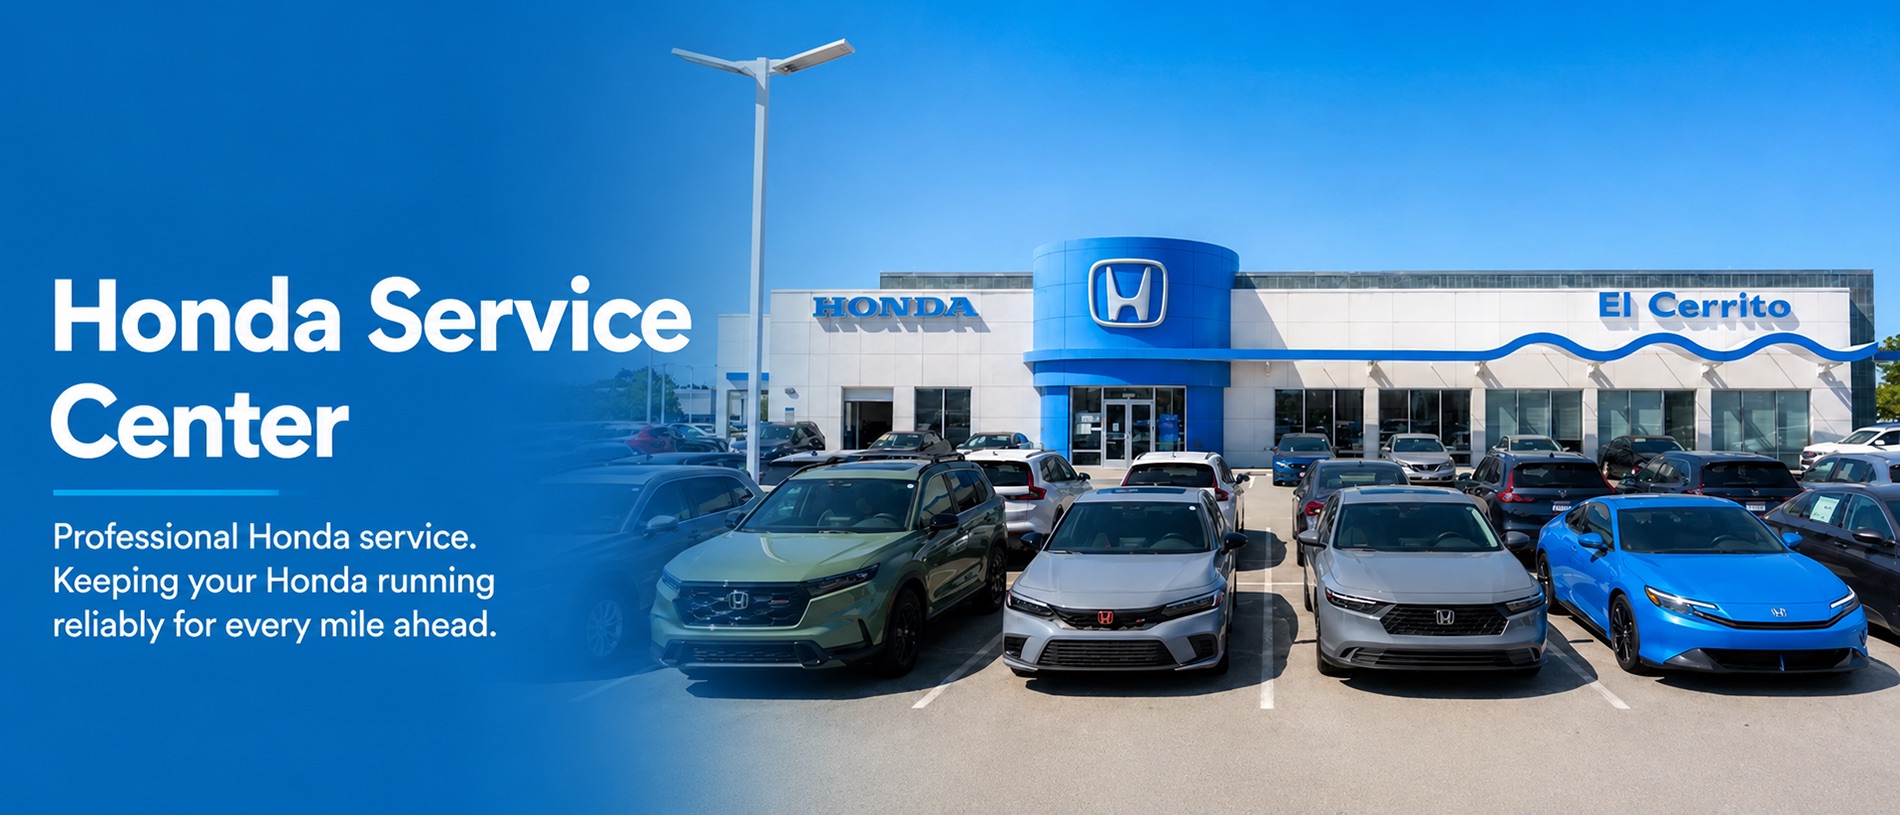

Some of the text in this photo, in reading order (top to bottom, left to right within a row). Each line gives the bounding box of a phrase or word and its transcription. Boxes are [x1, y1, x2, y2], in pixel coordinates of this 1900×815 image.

[812, 295, 980, 319] HONDA
[1598, 291, 1792, 319] El Cerrito
